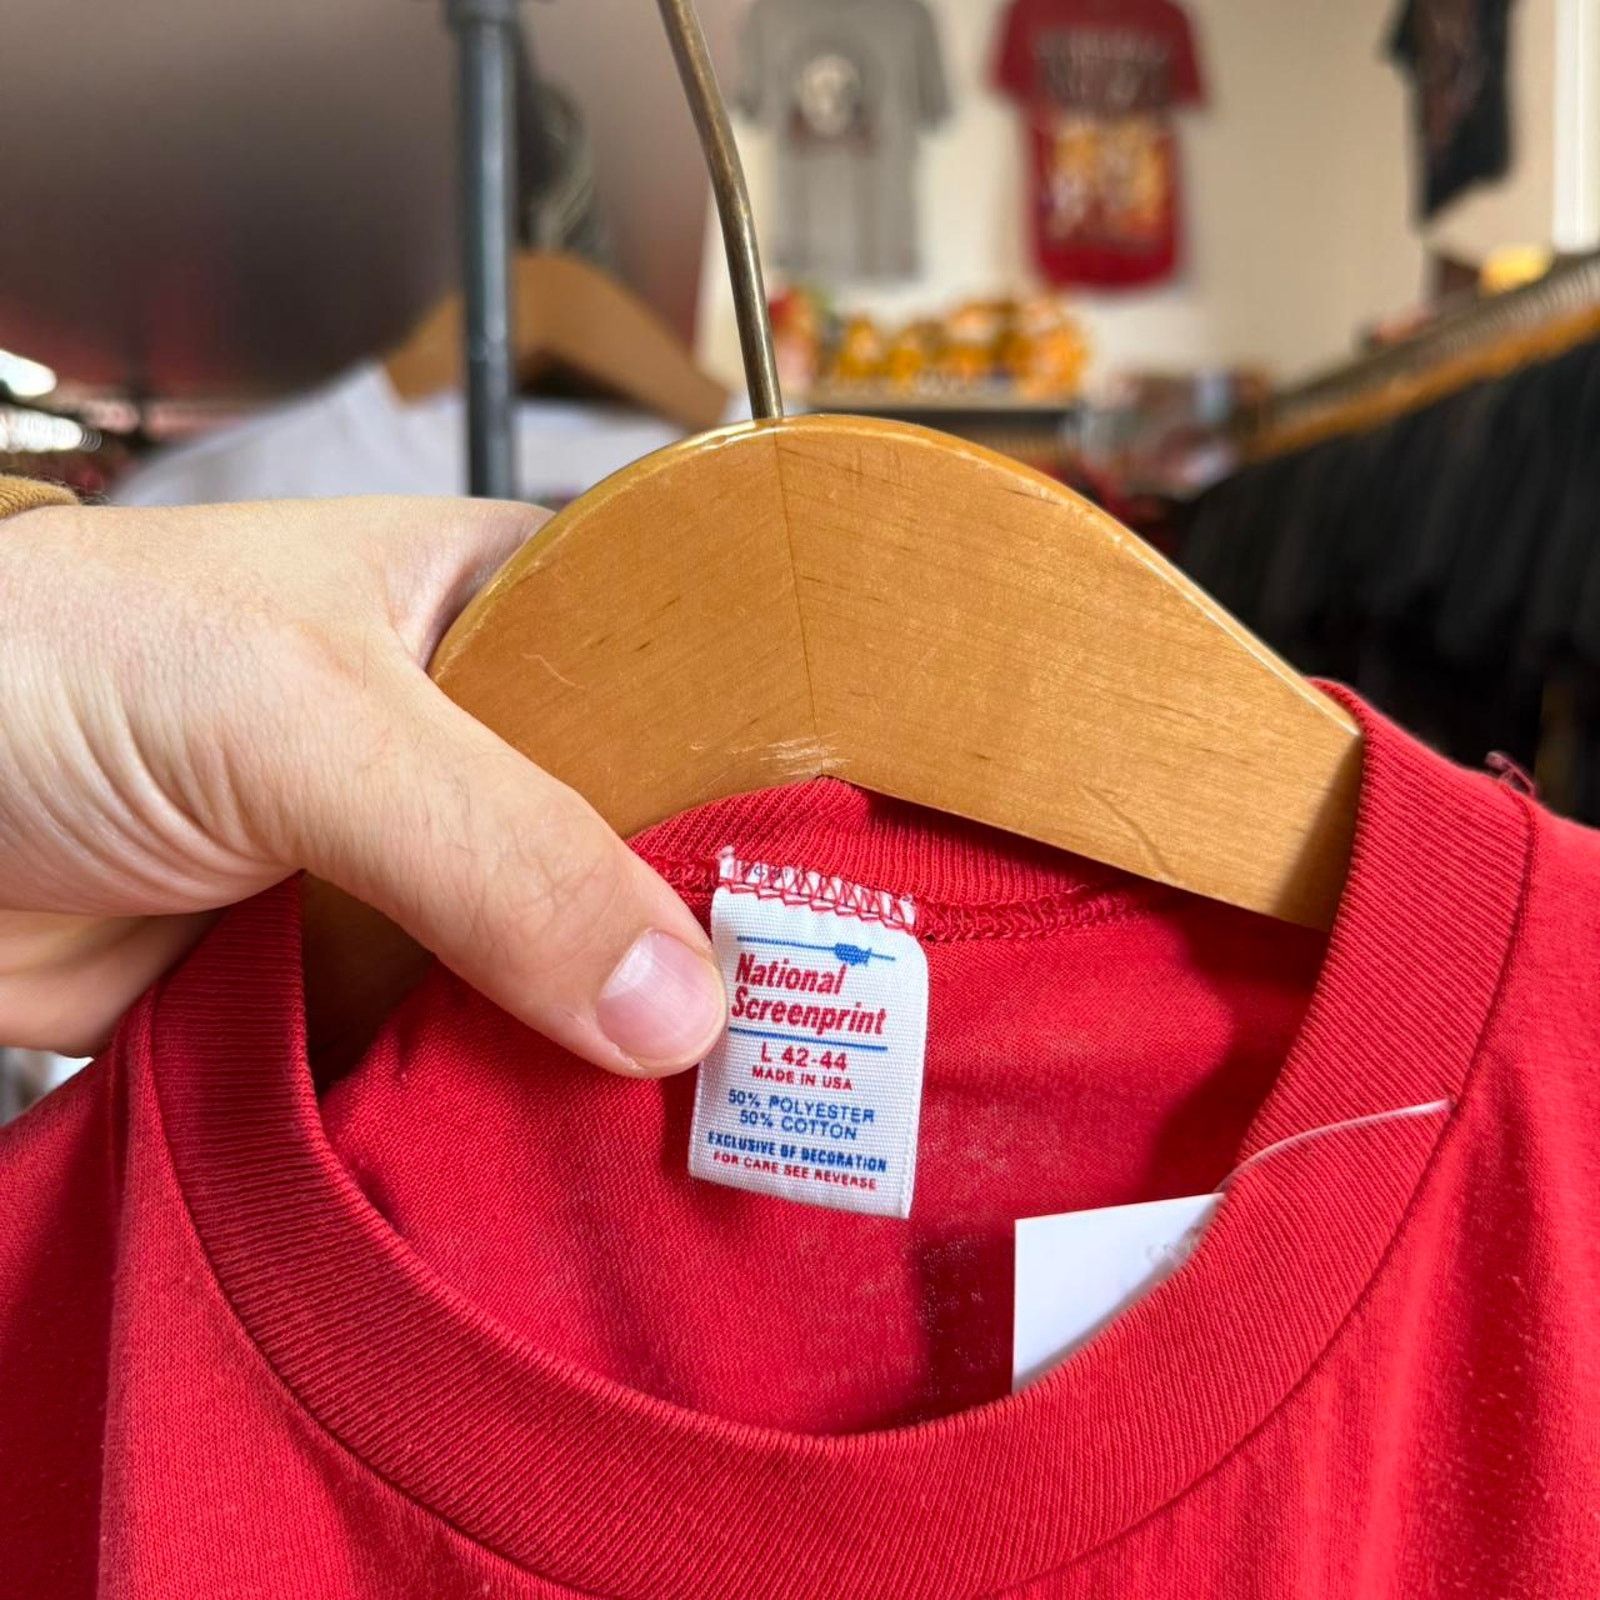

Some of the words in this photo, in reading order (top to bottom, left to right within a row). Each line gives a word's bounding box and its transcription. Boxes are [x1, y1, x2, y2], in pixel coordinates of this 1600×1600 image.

[735, 952, 847, 995] National
[731, 985, 887, 1035] Screenprint
[761, 1041, 772, 1063] L
[781, 1045, 848, 1071] 42-44
[752, 1065, 795, 1085] MADE
[801, 1073, 817, 1086] IN
[823, 1075, 853, 1091] USA
[728, 1088, 761, 1108] 50%
[769, 1094, 875, 1123] POLYESTER
[740, 1109, 774, 1128] 50%
[781, 1115, 858, 1141] COTTON
[708, 1131, 776, 1156] EXCLUSIVE
[780, 1144, 798, 1159] OF
[801, 1146, 888, 1173] DECORATION
[713, 1151, 739, 1165] FOR
[744, 1156, 779, 1174] CARE
[783, 1164, 810, 1180] SEE
[814, 1170, 878, 1190] REVERSE
